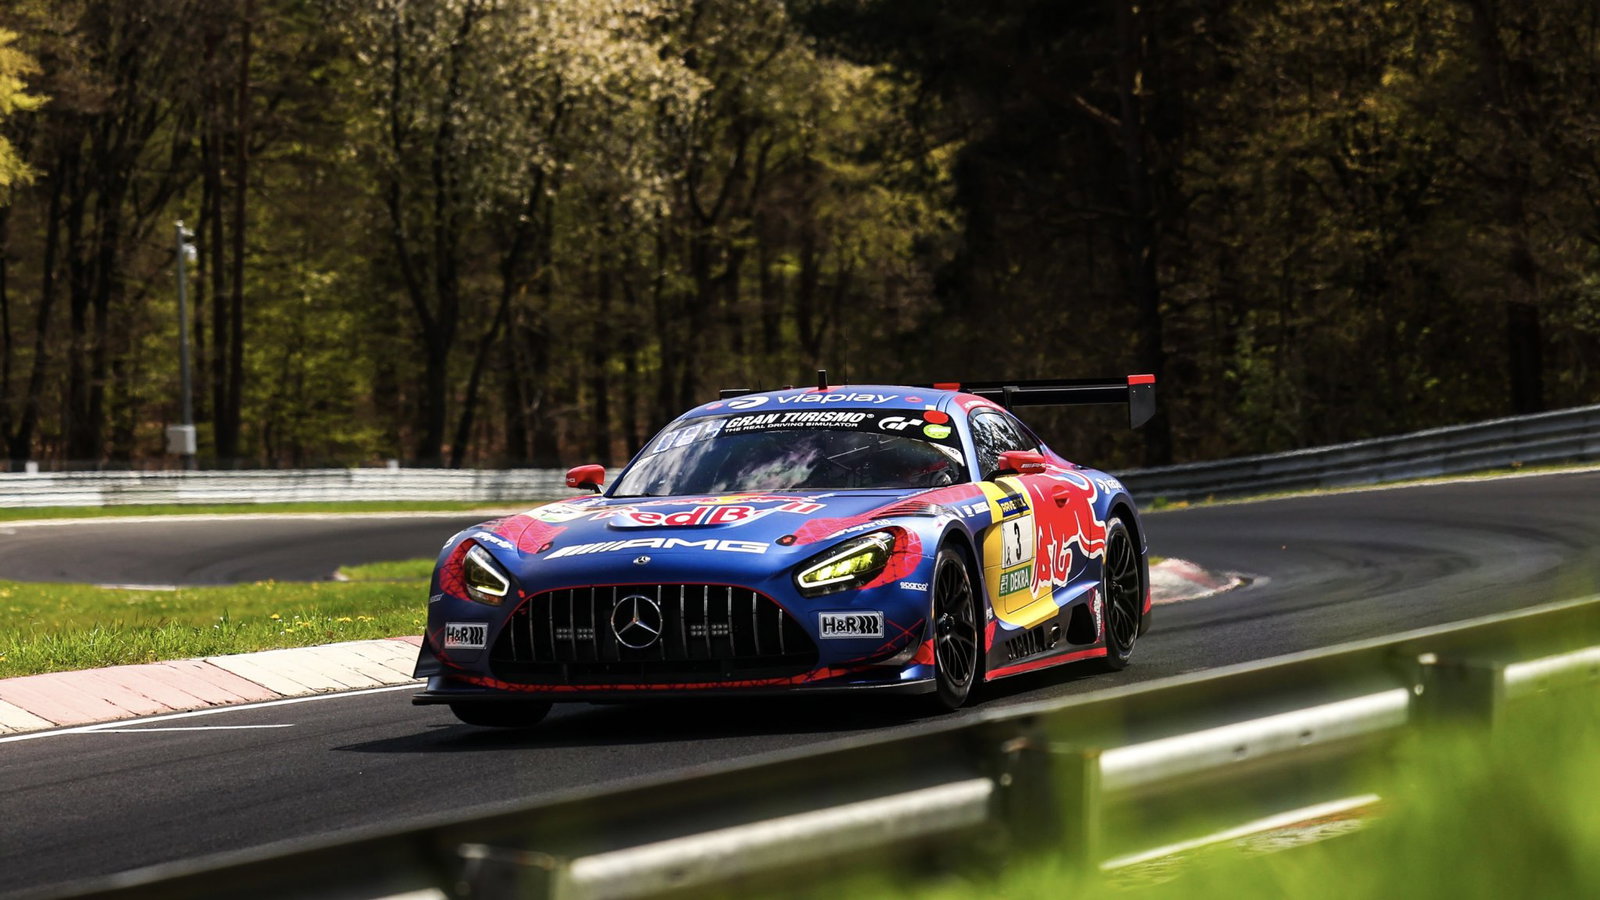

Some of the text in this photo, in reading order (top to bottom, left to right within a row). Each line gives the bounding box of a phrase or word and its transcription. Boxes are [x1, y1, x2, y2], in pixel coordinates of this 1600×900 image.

[778, 393, 898, 404] viaplay
[726, 413, 780, 428] GRAN
[708, 502, 822, 525] Bll
[609, 538, 770, 554] AMG
[1014, 523, 1021, 560] 3
[1010, 568, 1030, 592] DEKRA
[822, 616, 859, 634] H&R
[446, 626, 469, 643] H&R
